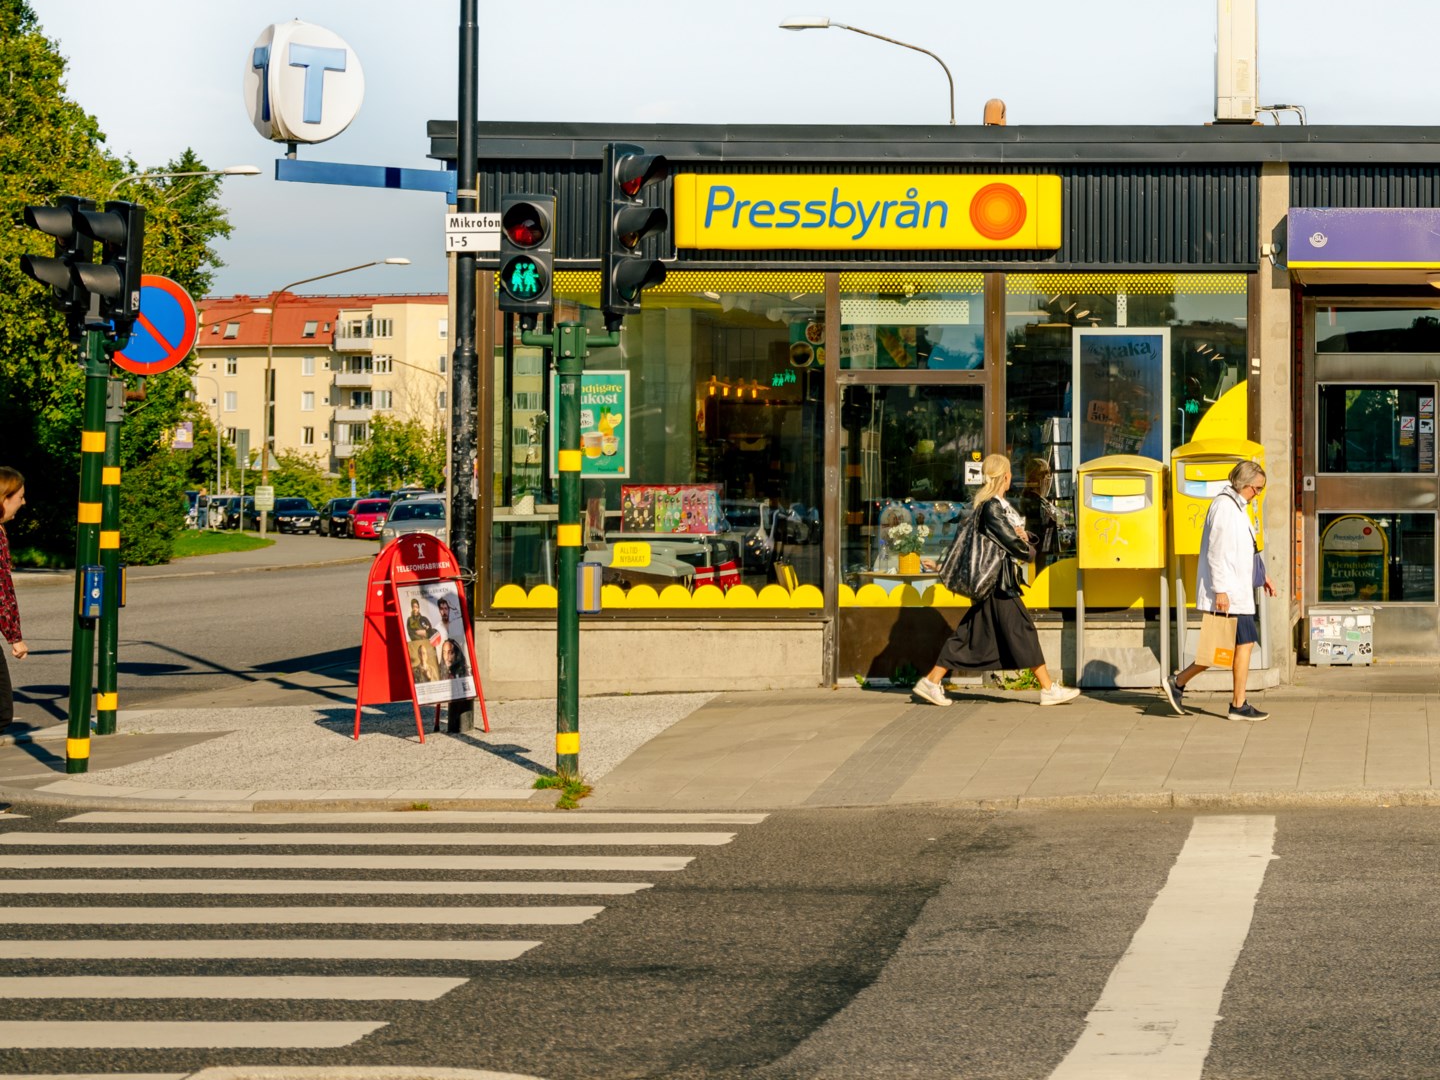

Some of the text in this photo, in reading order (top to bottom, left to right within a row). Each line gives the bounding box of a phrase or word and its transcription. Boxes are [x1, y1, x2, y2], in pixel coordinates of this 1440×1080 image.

[288, 42, 347, 125] T
[704, 185, 948, 240] Pressbyrån
[450, 236, 468, 247] 1-5
[581, 393, 618, 404] ukost
[396, 561, 450, 573] TELEFONFABRIKEN
